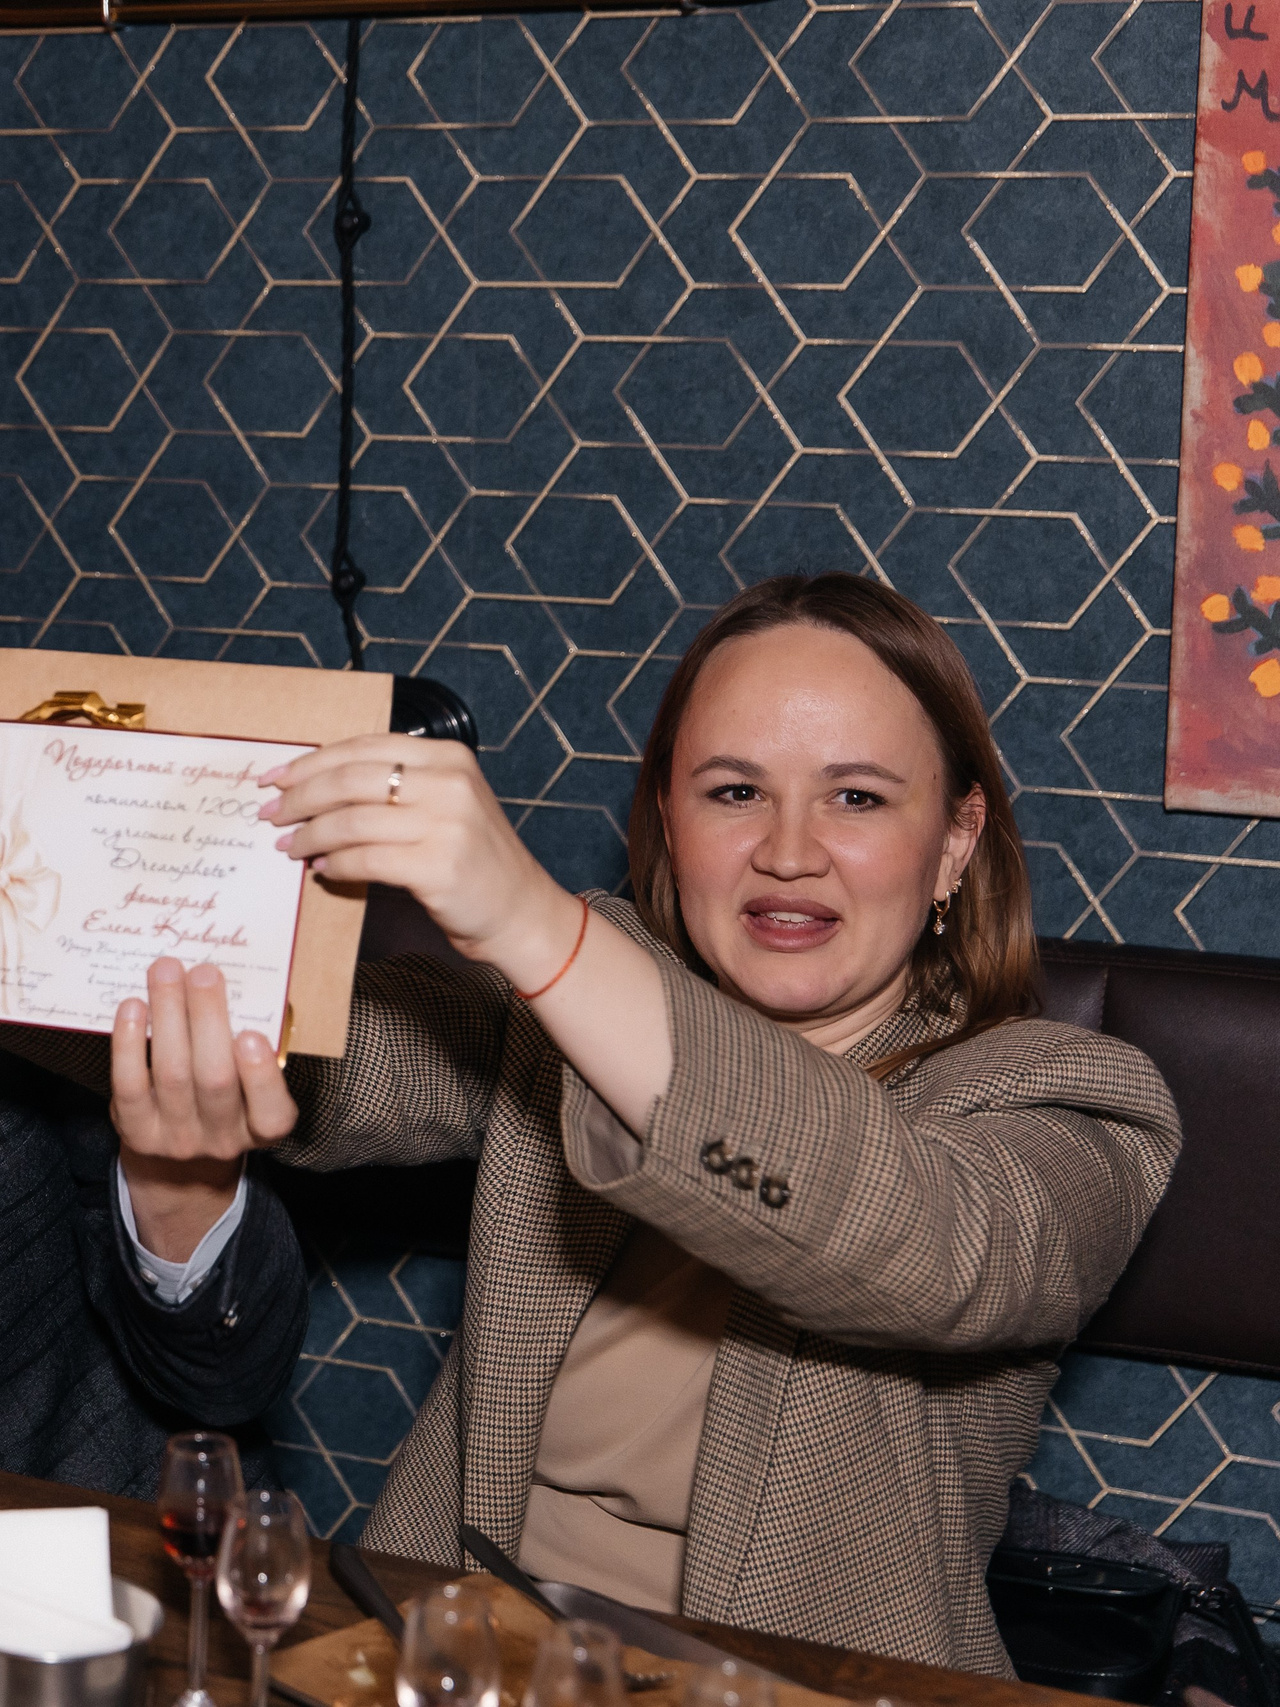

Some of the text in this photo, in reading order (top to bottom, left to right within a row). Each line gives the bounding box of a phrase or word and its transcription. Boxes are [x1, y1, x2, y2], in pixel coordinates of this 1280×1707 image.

[43, 738, 175, 782] Подарочный
[84, 793, 187, 812] номиналом
[103, 828, 175, 848] участие
[182, 826, 195, 843] в
[117, 883, 219, 916] фотограф
[82, 909, 143, 936] Елена
